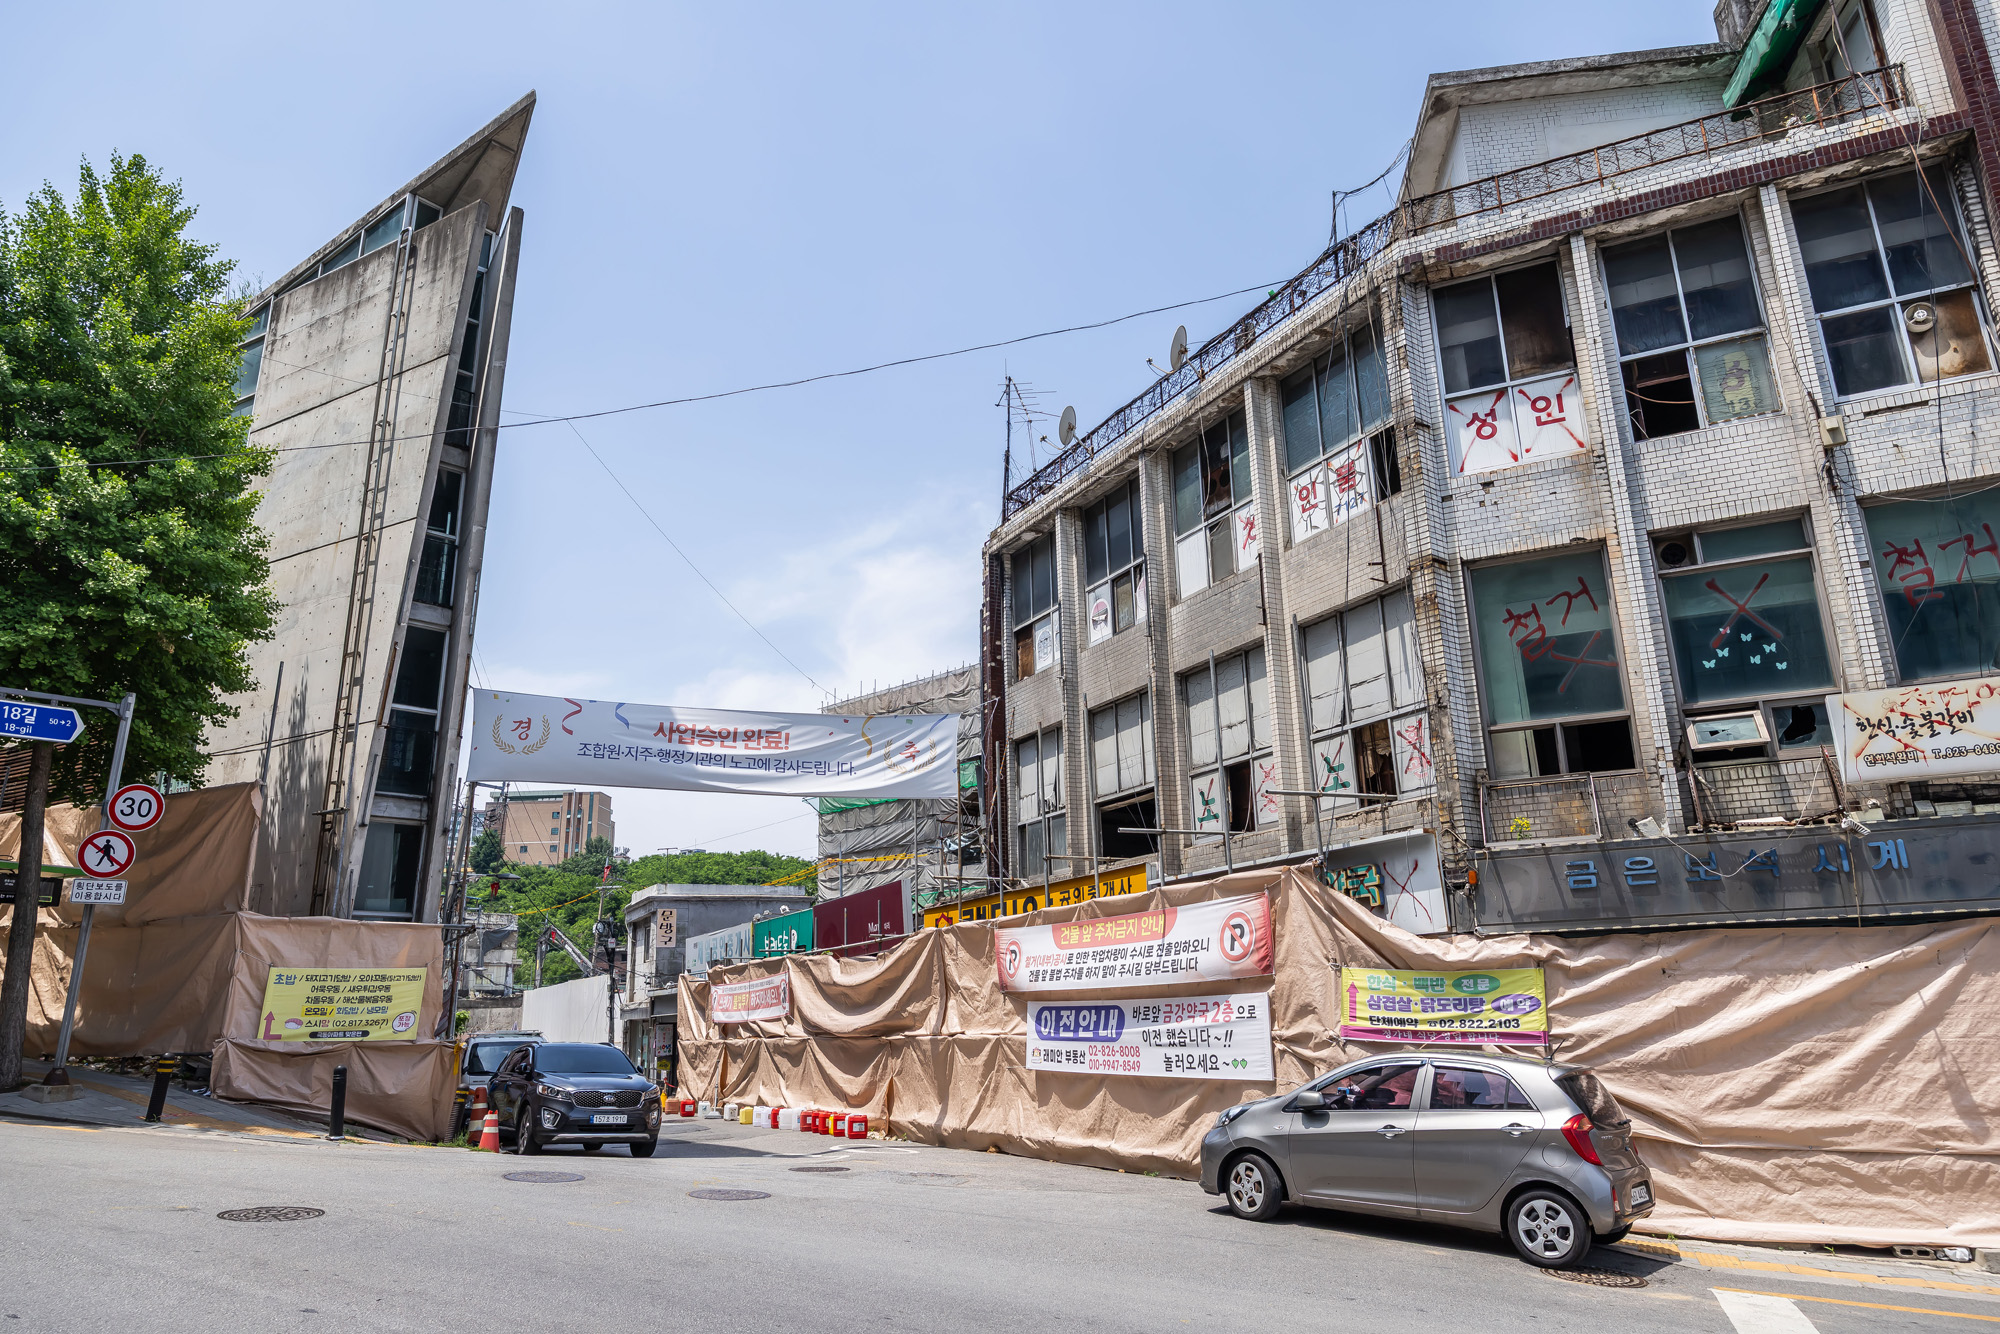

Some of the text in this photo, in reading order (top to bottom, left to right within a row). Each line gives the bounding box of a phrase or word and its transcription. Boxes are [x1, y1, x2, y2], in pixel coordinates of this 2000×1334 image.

[1882, 522, 2000, 607] 철거
[1502, 576, 1598, 661] 철거
[3, 706, 37, 724] 18길
[5, 723, 32, 734] 18-gil
[511, 717, 531, 741] 경
[653, 721, 790, 750] 사업승인 완료!
[577, 742, 856, 775] 조합원·지주·행정기관의 노고에 감사드립니다.
[900, 741, 920, 762] 축
[120, 796, 153, 818] 30
[74, 891, 122, 901] 이용합시다
[75, 881, 123, 892] 횡단보도를
[660, 910, 673, 945] 문방구
[1060, 914, 1165, 945] 건물 앞 주차금지 안내
[1075, 951, 1089, 965] 인한
[1091, 946, 1128, 963] 작업차량이
[1130, 945, 1154, 960] 수시로
[1156, 937, 1210, 957] 진출입하오니
[1029, 956, 1198, 982] 건물 앞 불법 주차를 하지 말아 주시길 당부드립니다
[273, 973, 297, 985] 초밥
[1366, 974, 1490, 993] 한식 백반 전문
[1500, 998, 1531, 1011] 예약
[1041, 1009, 1119, 1038] 이전안내
[1369, 1015, 1419, 1028] 단체예약
[1142, 1029, 1162, 1047] 이전
[1417, 1030, 1437, 1040] 식당
[1441, 1032, 1462, 1041] 영업
[1043, 1049, 1086, 1064] 래미안 부동산
[1089, 1045, 1140, 1058] 02-826-8008
[1089, 1060, 1140, 1072] 010-9947-8549
